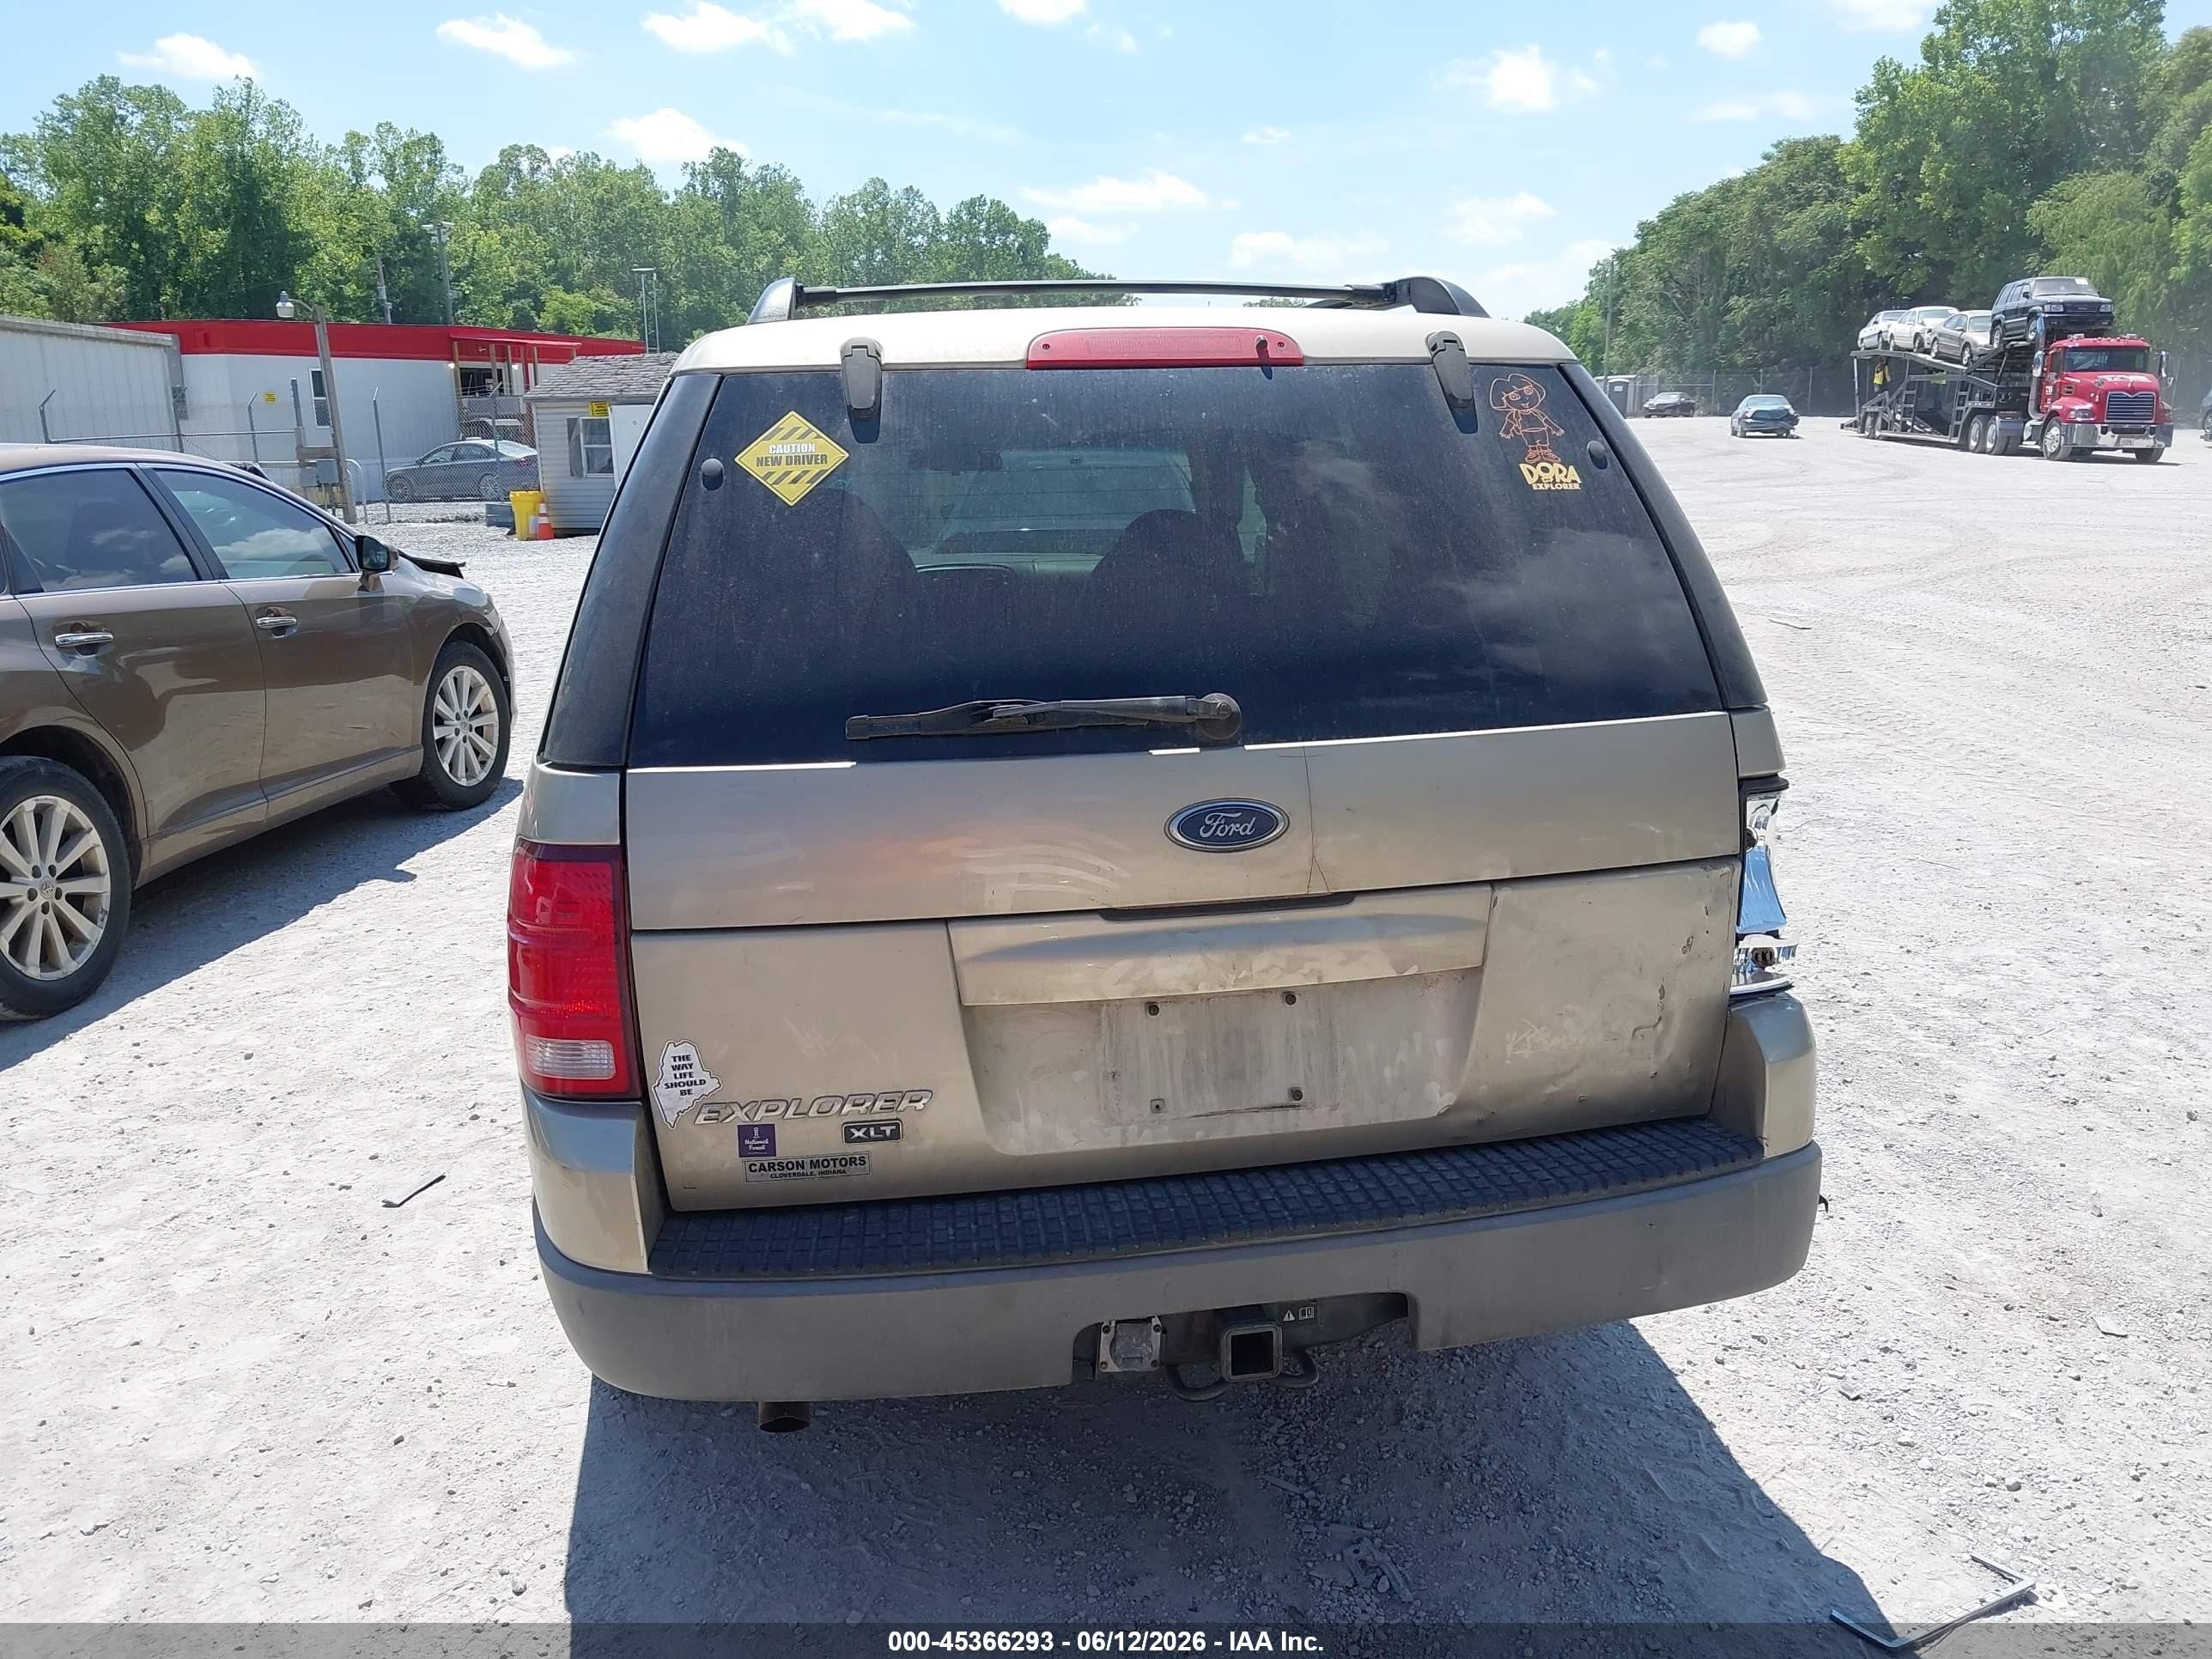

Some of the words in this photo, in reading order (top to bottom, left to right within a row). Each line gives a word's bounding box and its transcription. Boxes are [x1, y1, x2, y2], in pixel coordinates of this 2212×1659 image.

[769, 443, 816, 454] CAUTION
[756, 455, 783, 467] NEW
[785, 453, 828, 465] DRIVER
[1519, 462, 1582, 484] DORA
[1200, 812, 1256, 837] Ford
[664, 1079, 707, 1089] SHOULD
[693, 1090, 933, 1125] EXPLORER
[849, 1125, 896, 1139] XLT
[748, 1160, 805, 1173] CARSON
[810, 1156, 866, 1170] MOTORS
[769, 1170, 816, 1179] CLOVERDALE,
